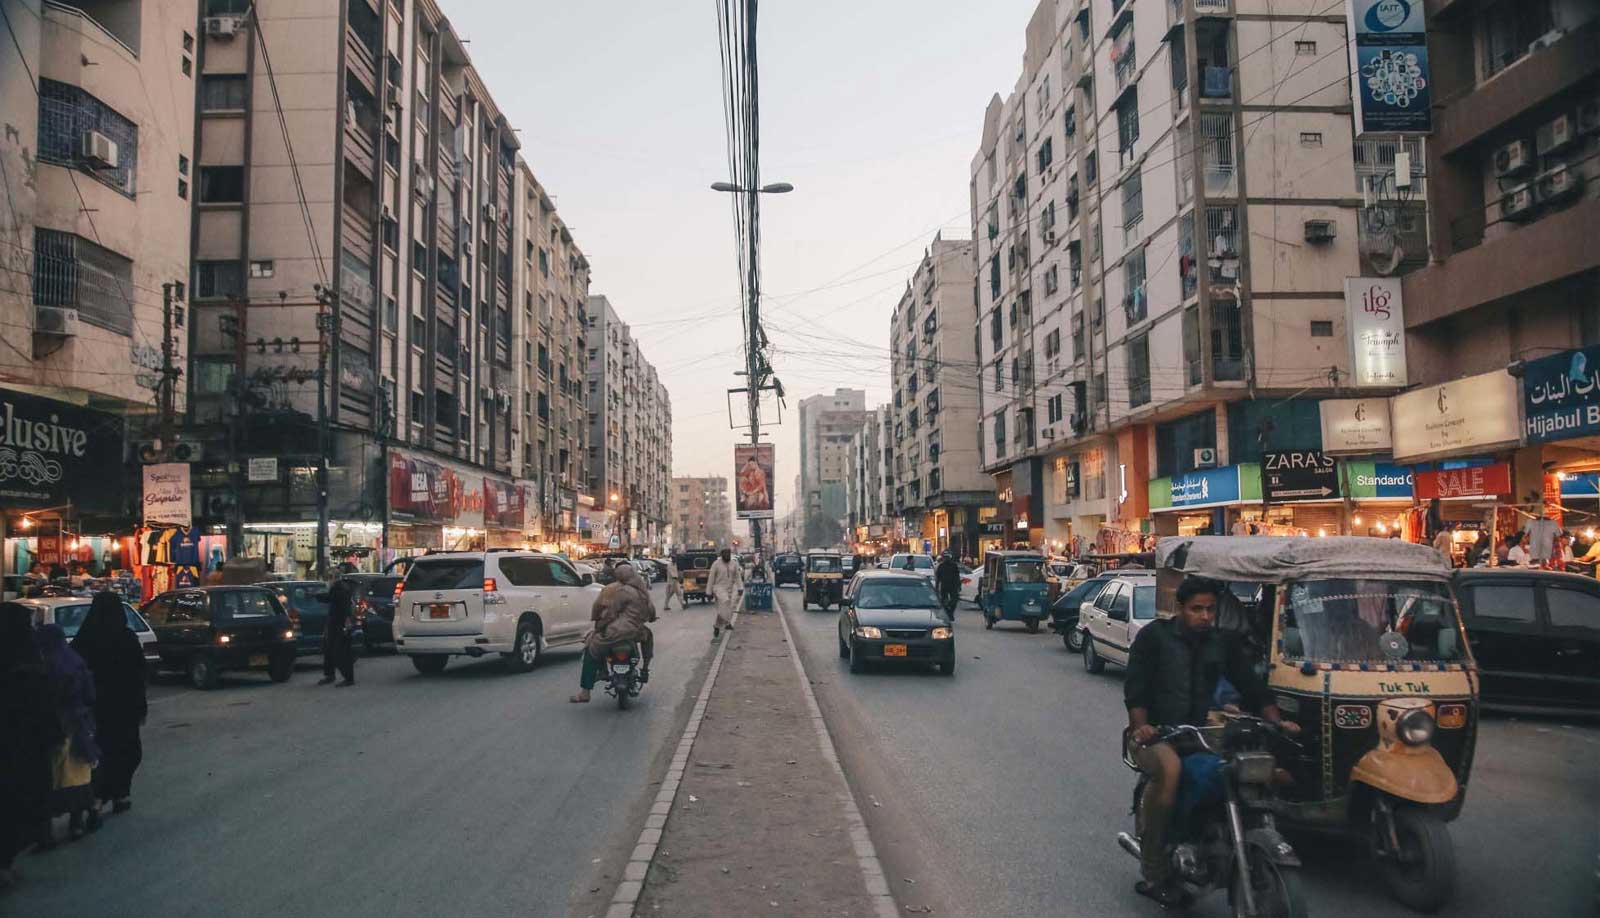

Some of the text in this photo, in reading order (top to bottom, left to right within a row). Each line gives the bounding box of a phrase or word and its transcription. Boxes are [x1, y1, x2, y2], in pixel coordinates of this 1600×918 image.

[1527, 408, 1580, 437] Hijabul
[1265, 451, 1334, 470] ZARA'S
[1356, 474, 1406, 486] Standard
[1437, 467, 1484, 496] SALE
[1379, 681, 1430, 693] Tuk Tuk
